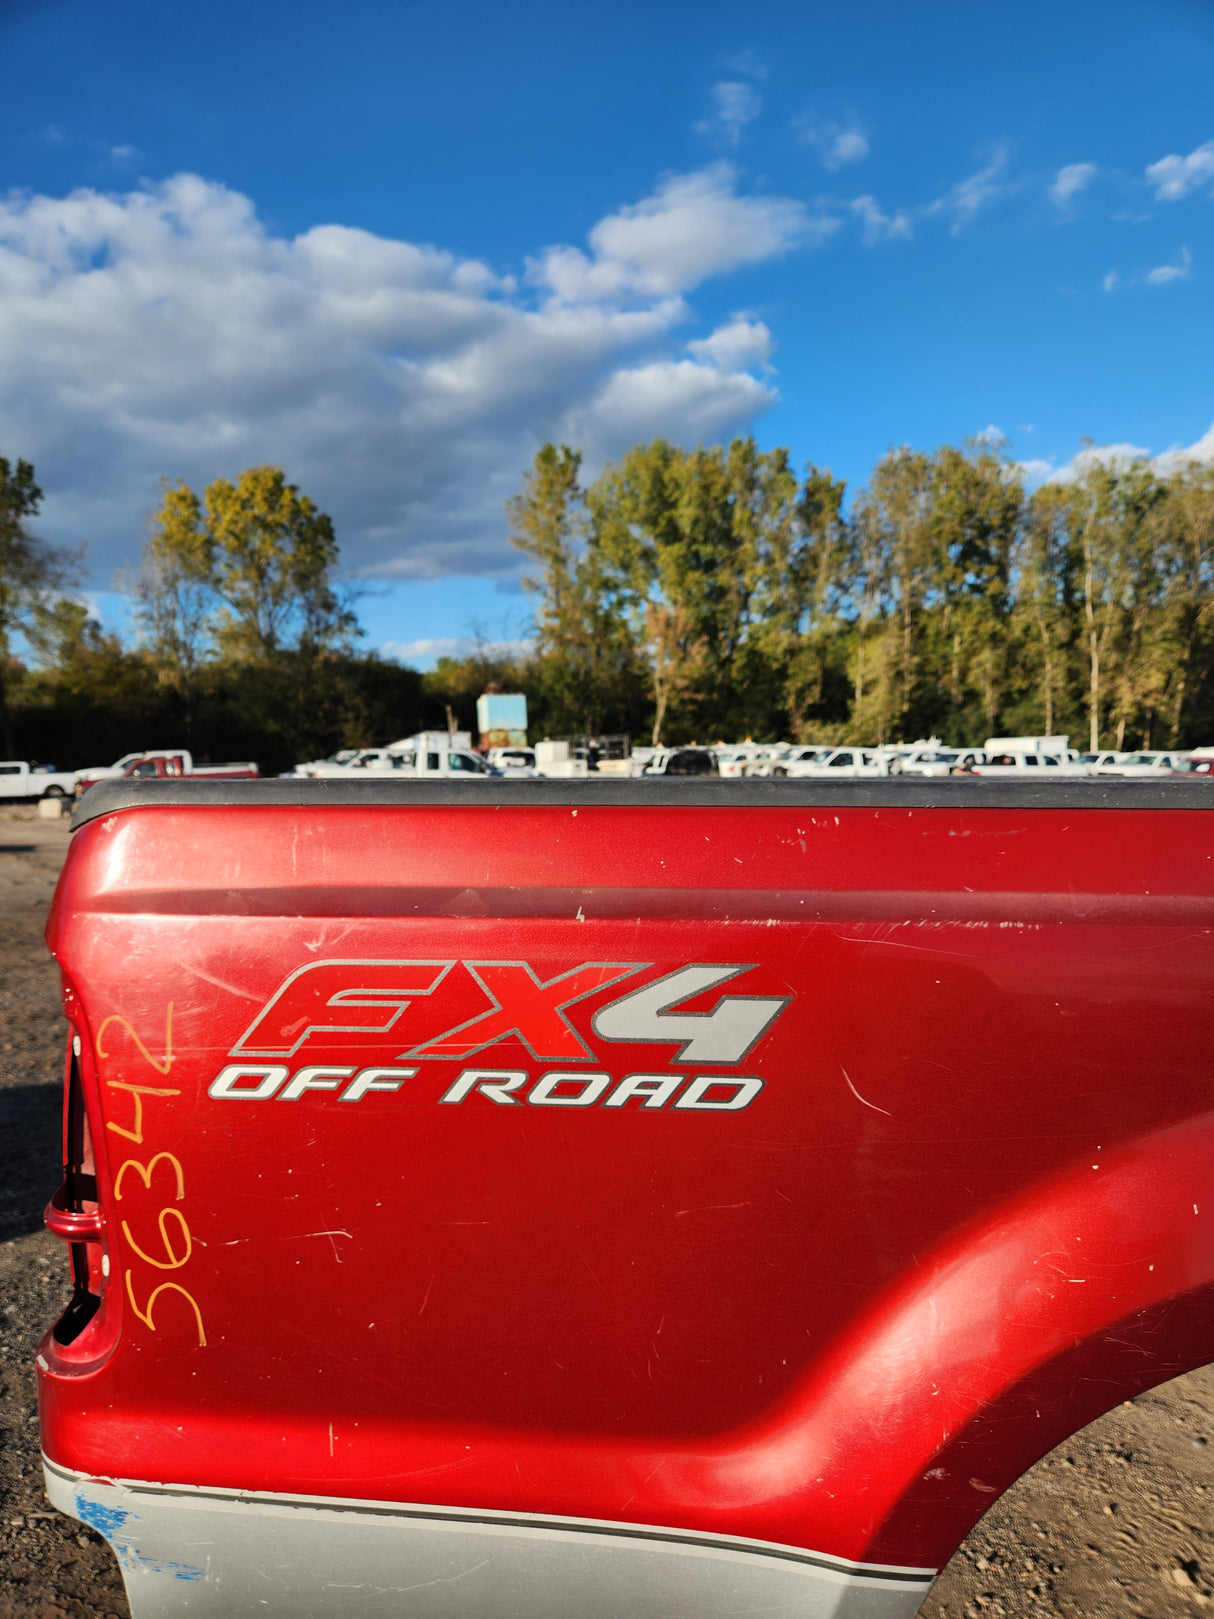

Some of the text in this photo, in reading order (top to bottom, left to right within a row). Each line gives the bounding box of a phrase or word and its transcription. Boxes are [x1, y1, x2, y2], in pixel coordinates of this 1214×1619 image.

[227, 958, 796, 1065] FX4
[207, 1064, 765, 1111] OFF ROAD
[95, 1001, 207, 1347] 56342
